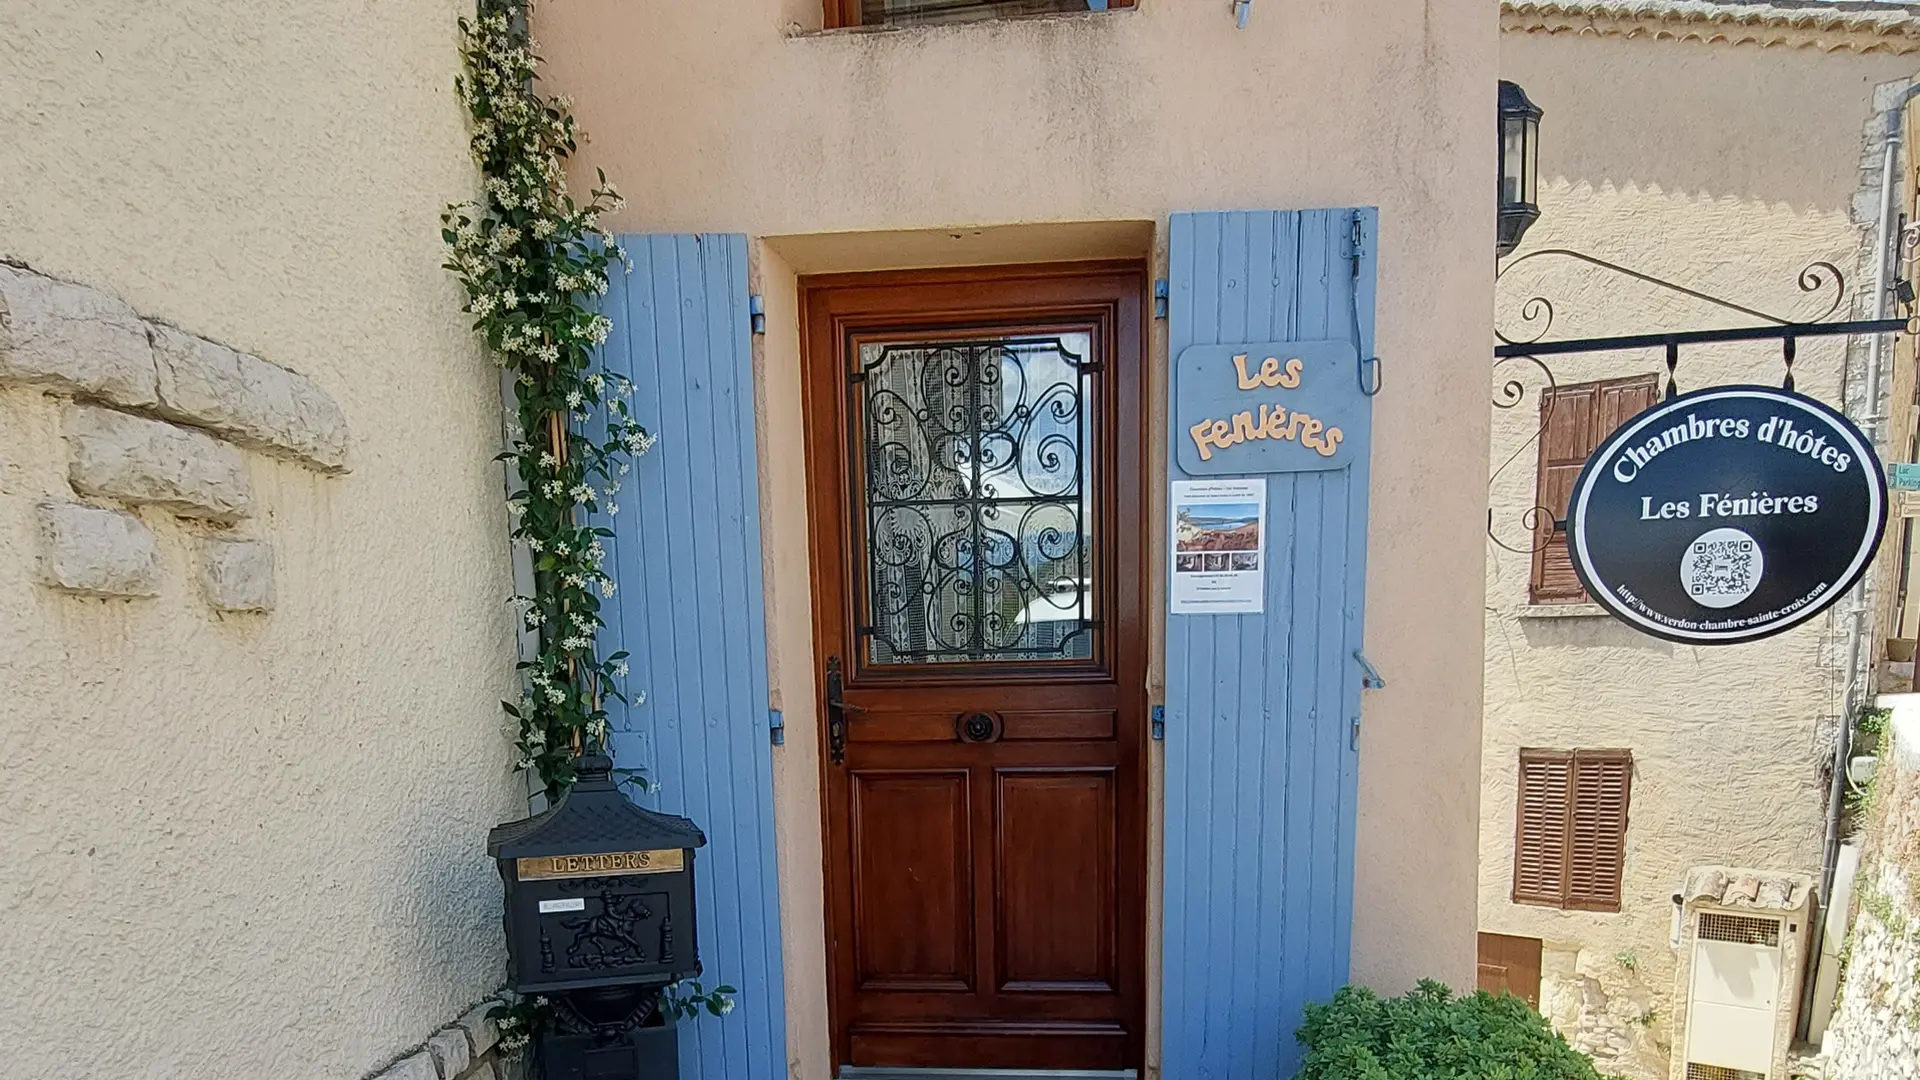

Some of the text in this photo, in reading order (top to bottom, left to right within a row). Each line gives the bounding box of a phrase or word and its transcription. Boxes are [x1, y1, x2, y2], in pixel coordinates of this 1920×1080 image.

[1232, 352, 1303, 390] Les
[1614, 413, 1851, 483] Chambres d'hôtes
[1640, 491, 1818, 520] Les Fénières
[552, 853, 650, 873] LETTERS
